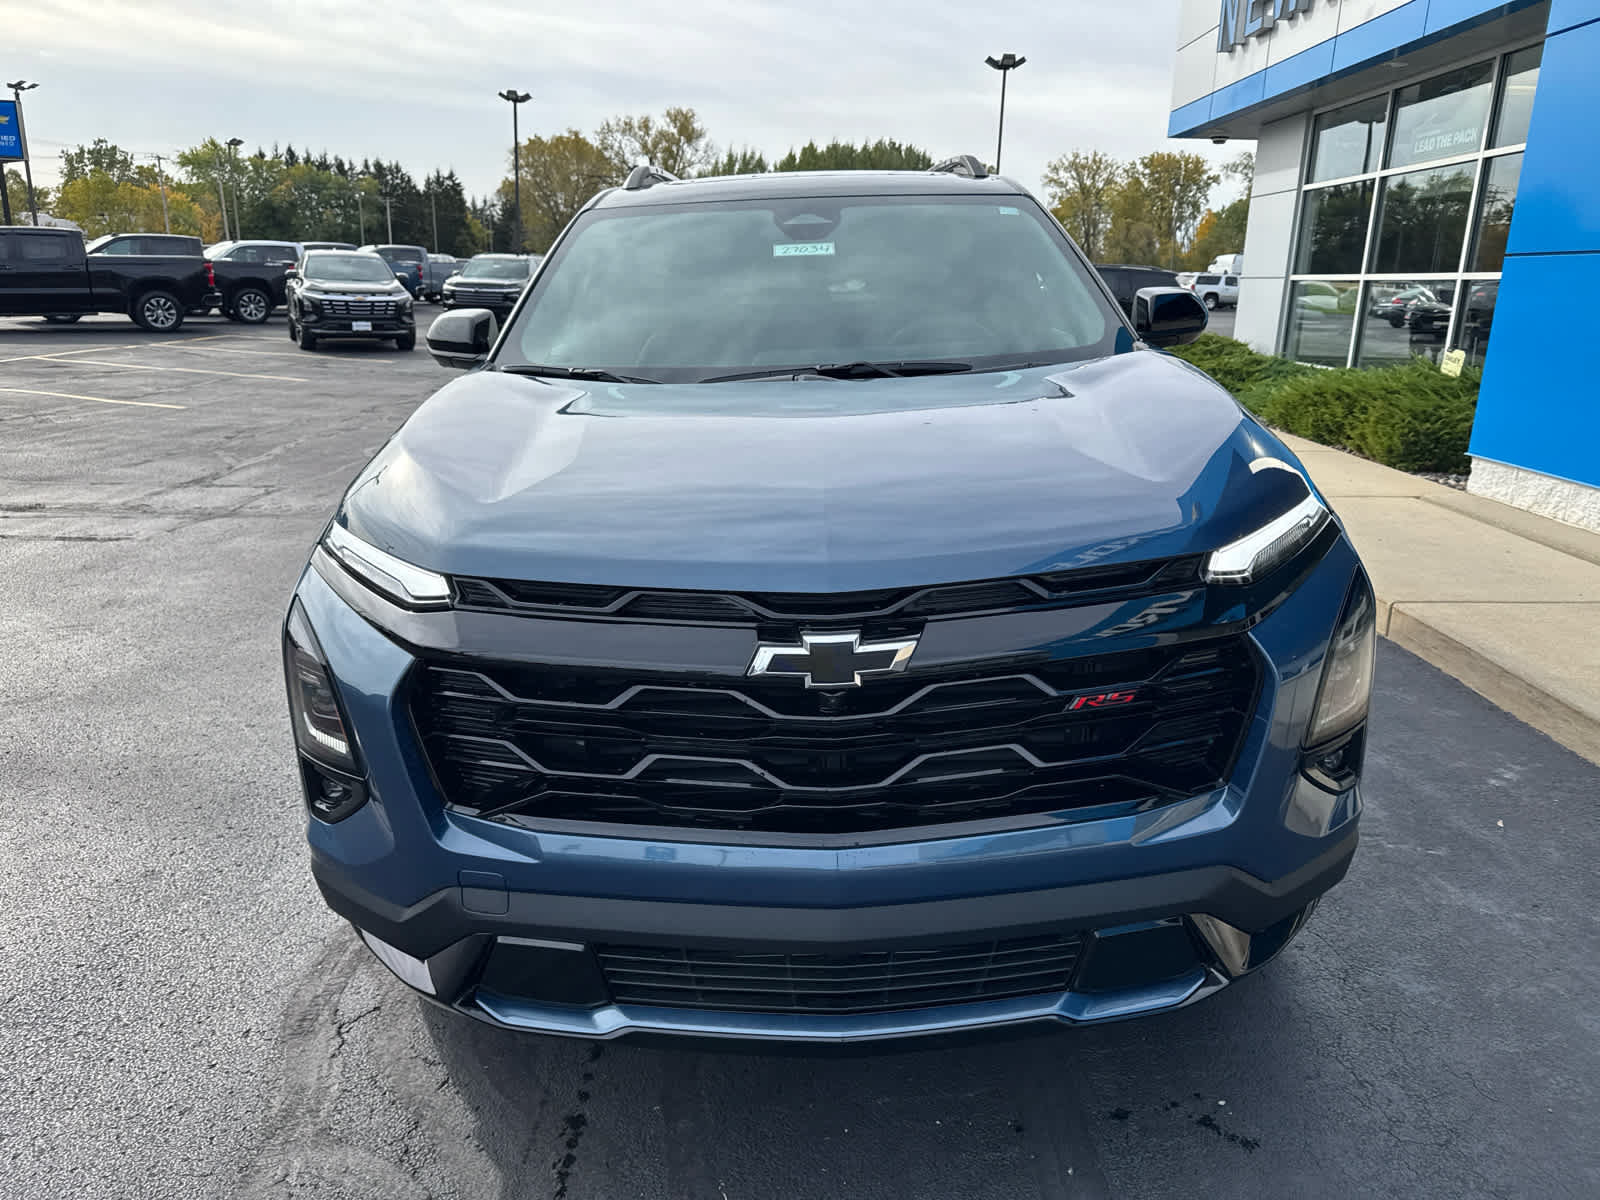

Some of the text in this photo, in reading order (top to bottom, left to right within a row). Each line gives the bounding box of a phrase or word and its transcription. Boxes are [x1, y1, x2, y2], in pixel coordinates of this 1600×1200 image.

[1436, 133, 1453, 149] THE
[1453, 128, 1478, 145] PACK
[1068, 690, 1136, 710] RS
